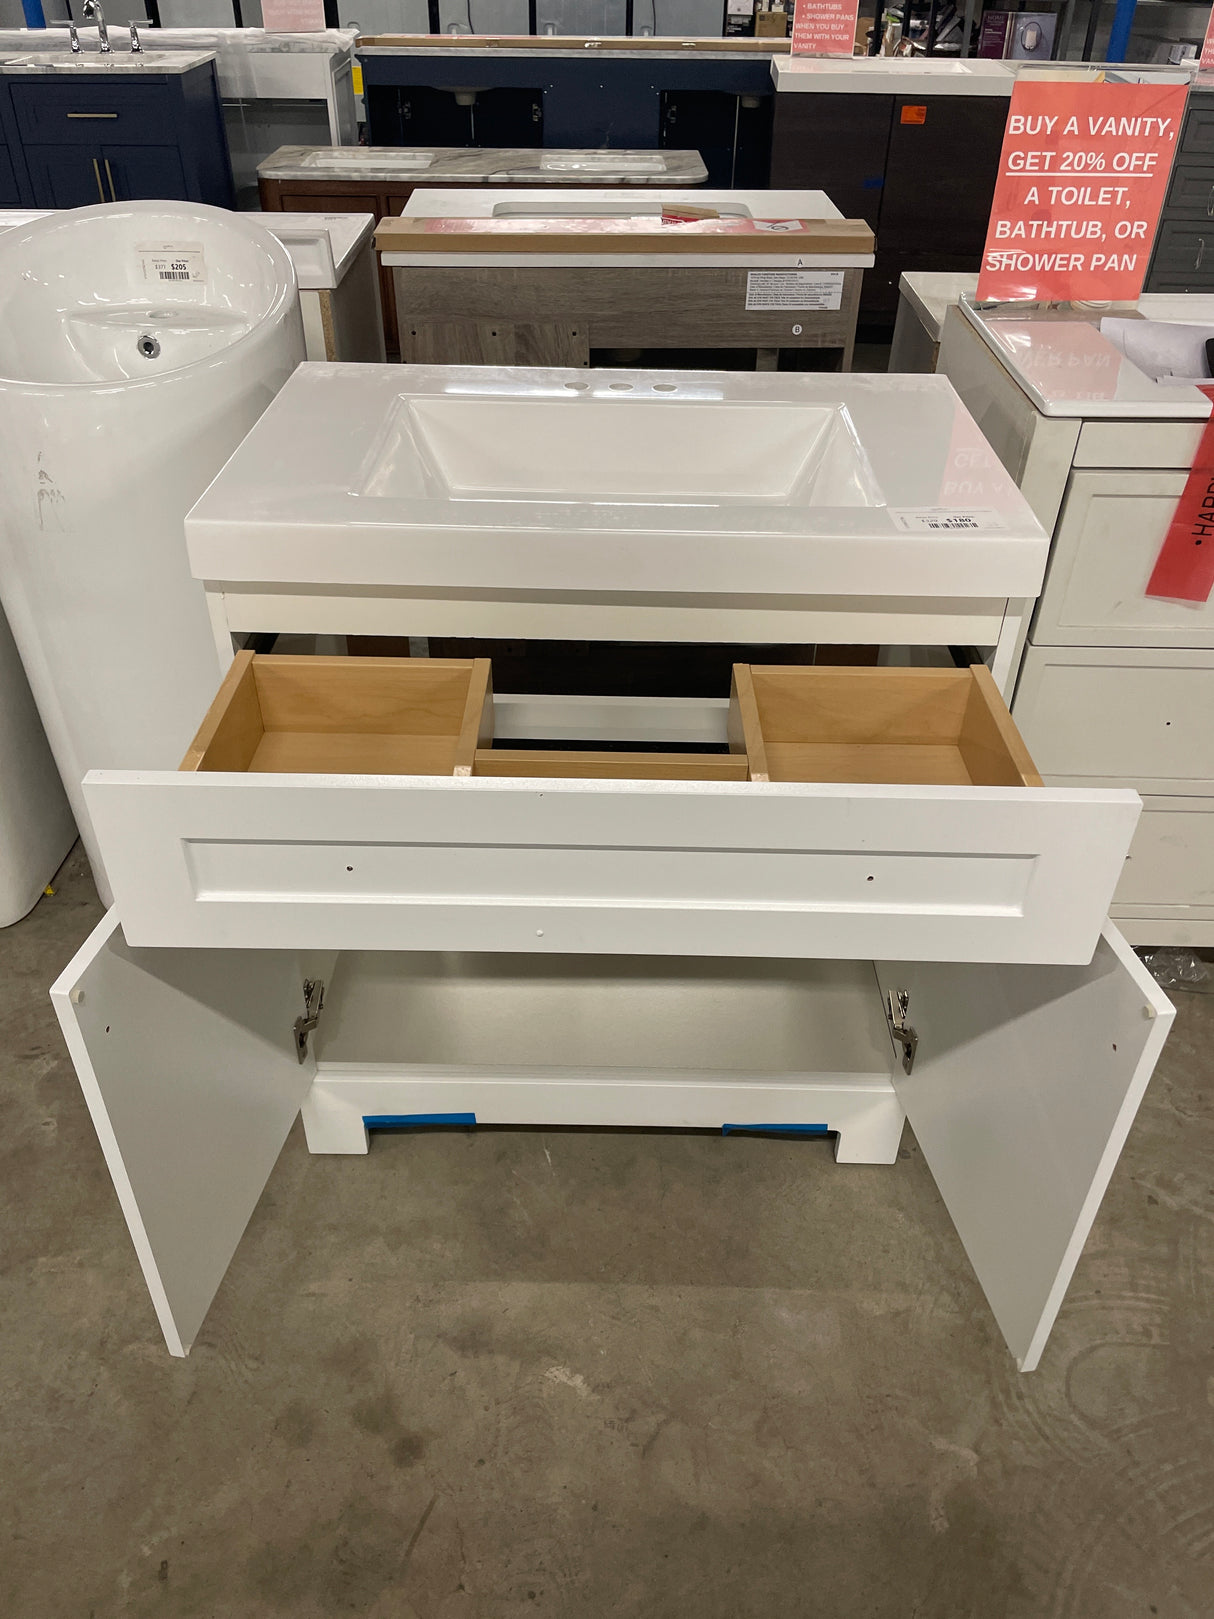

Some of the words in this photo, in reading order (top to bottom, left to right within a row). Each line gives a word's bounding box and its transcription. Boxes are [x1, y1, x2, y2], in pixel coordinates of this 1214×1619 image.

[1008, 116, 1058, 134] BUY
[1063, 116, 1079, 135] A
[1088, 116, 1174, 140] VANITY,
[1008, 152, 1056, 170] GET
[1060, 152, 1105, 171] 20%
[1112, 153, 1158, 172] OFF
[1024, 186, 1040, 205] A
[1048, 186, 1131, 208] TOILET,
[995, 220, 1106, 242] BATHTUB,
[1114, 221, 1148, 239] OR
[986, 254, 1085, 272] SHOWER
[1090, 254, 1137, 272] PAN
[1192, 477, 1214, 536] HAR
